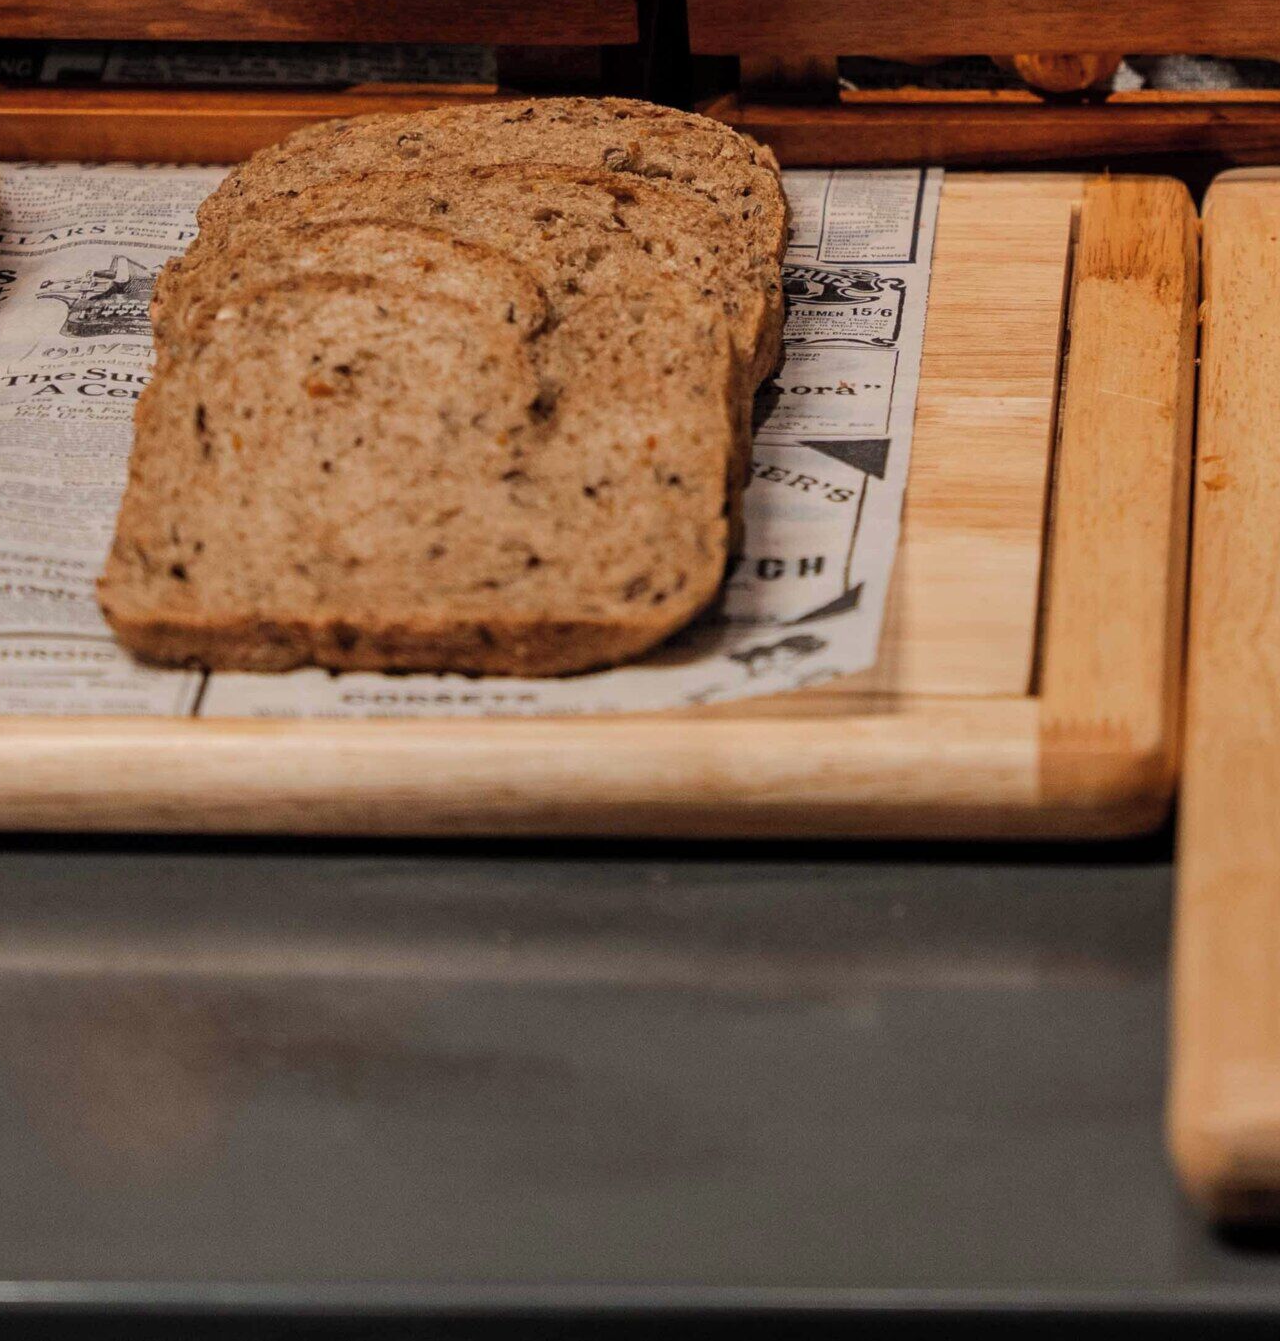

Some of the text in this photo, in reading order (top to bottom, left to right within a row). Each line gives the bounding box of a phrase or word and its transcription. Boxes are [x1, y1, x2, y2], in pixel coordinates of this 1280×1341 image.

[849, 307, 893, 318] 15/6
[0, 371, 77, 387] The
[31, 383, 67, 396] A
[754, 463, 855, 504] ER'S
